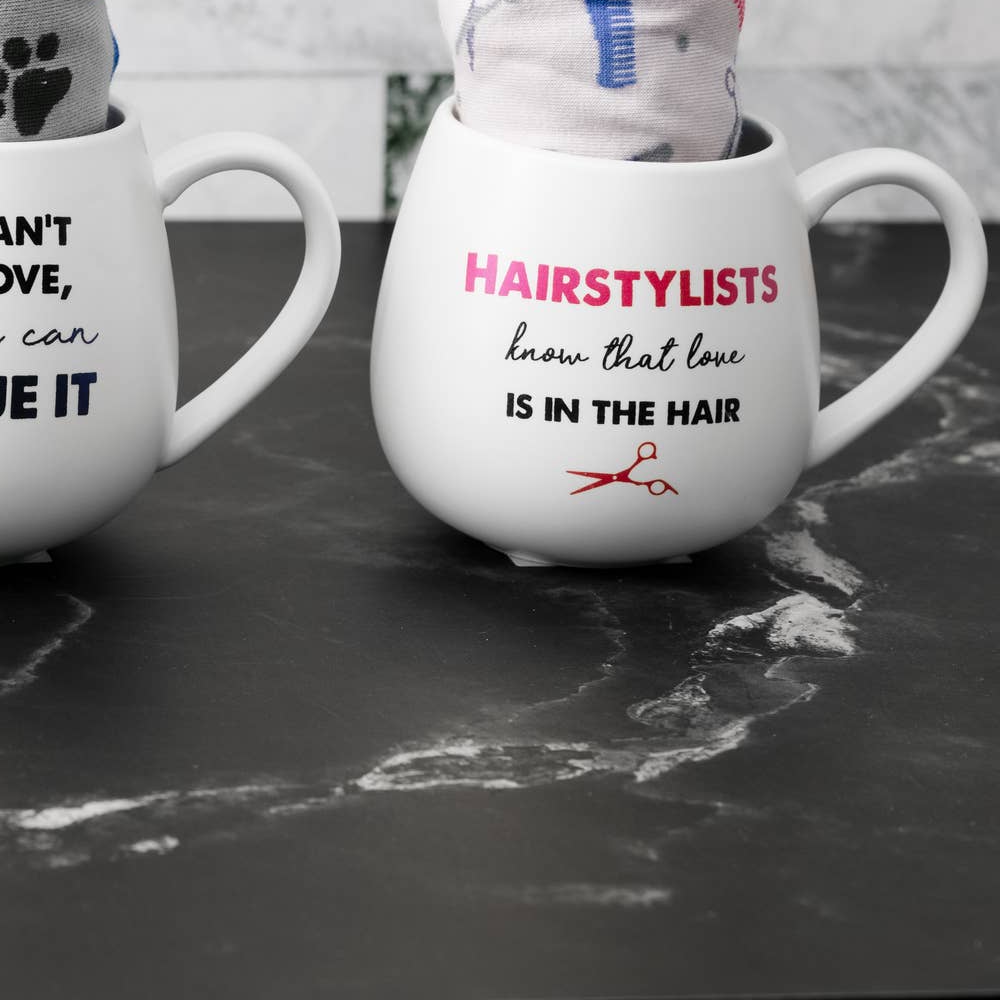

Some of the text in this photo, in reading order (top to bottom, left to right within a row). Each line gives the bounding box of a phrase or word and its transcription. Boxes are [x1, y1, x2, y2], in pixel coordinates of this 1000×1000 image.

[465, 251, 779, 308] HAIRSTYLISTS
[21, 326, 100, 347] can
[504, 321, 746, 372] know that love
[54, 372, 98, 418] IT
[506, 392, 741, 426] IS IN THE HAIR
